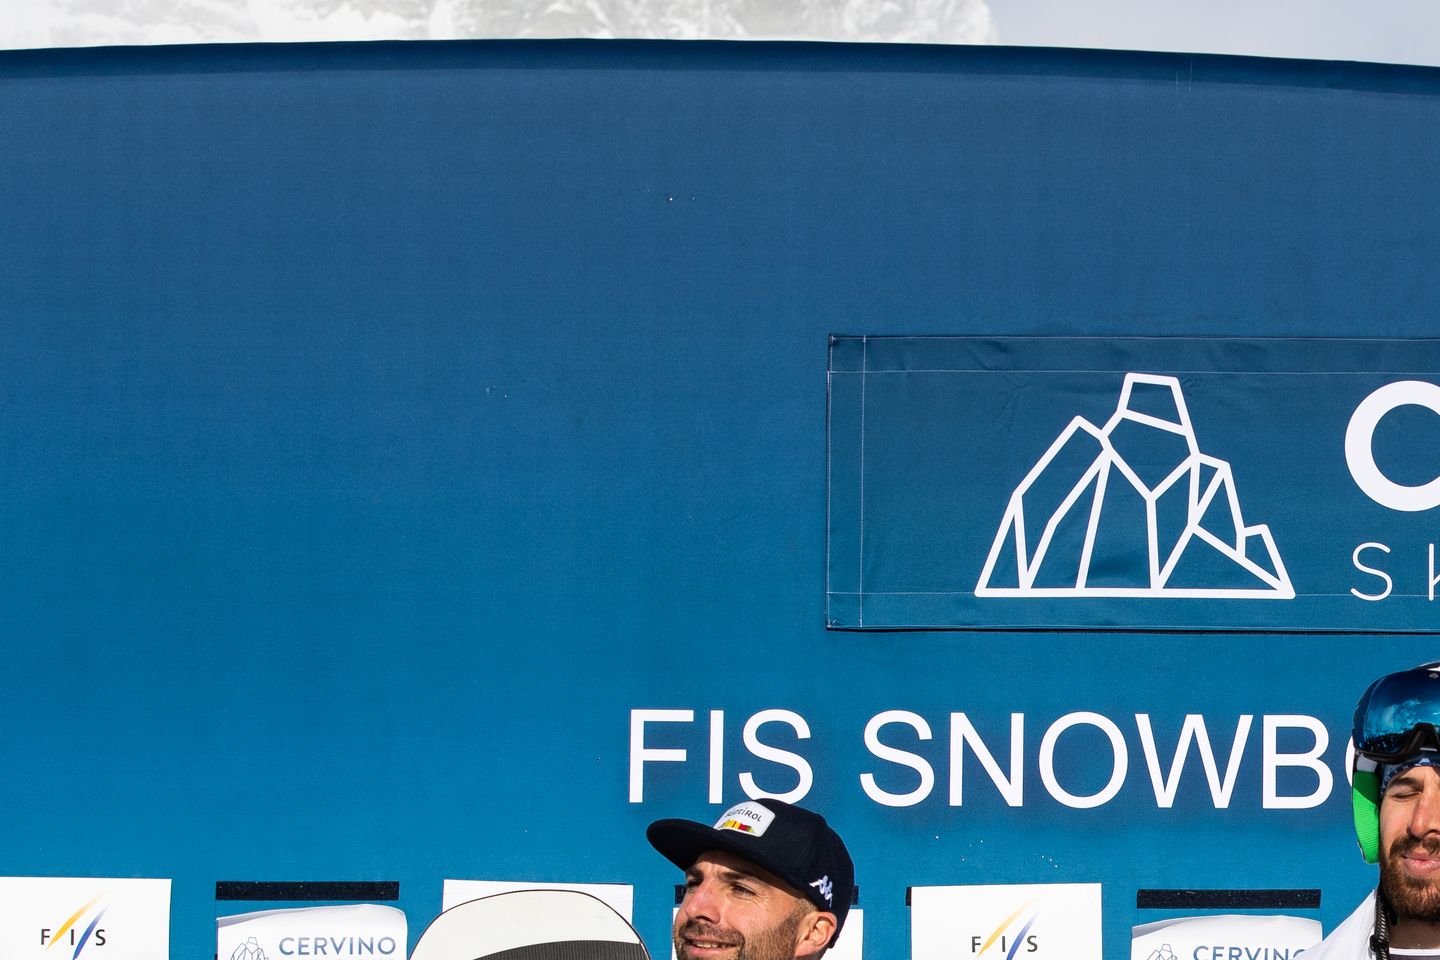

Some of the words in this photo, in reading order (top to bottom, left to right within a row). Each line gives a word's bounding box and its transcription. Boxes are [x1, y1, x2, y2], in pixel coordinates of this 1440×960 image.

[628, 708, 813, 806] FIS
[41, 928, 106, 946] FIS
[971, 935, 1039, 953] FIS
[279, 937, 396, 956] CERVINO
